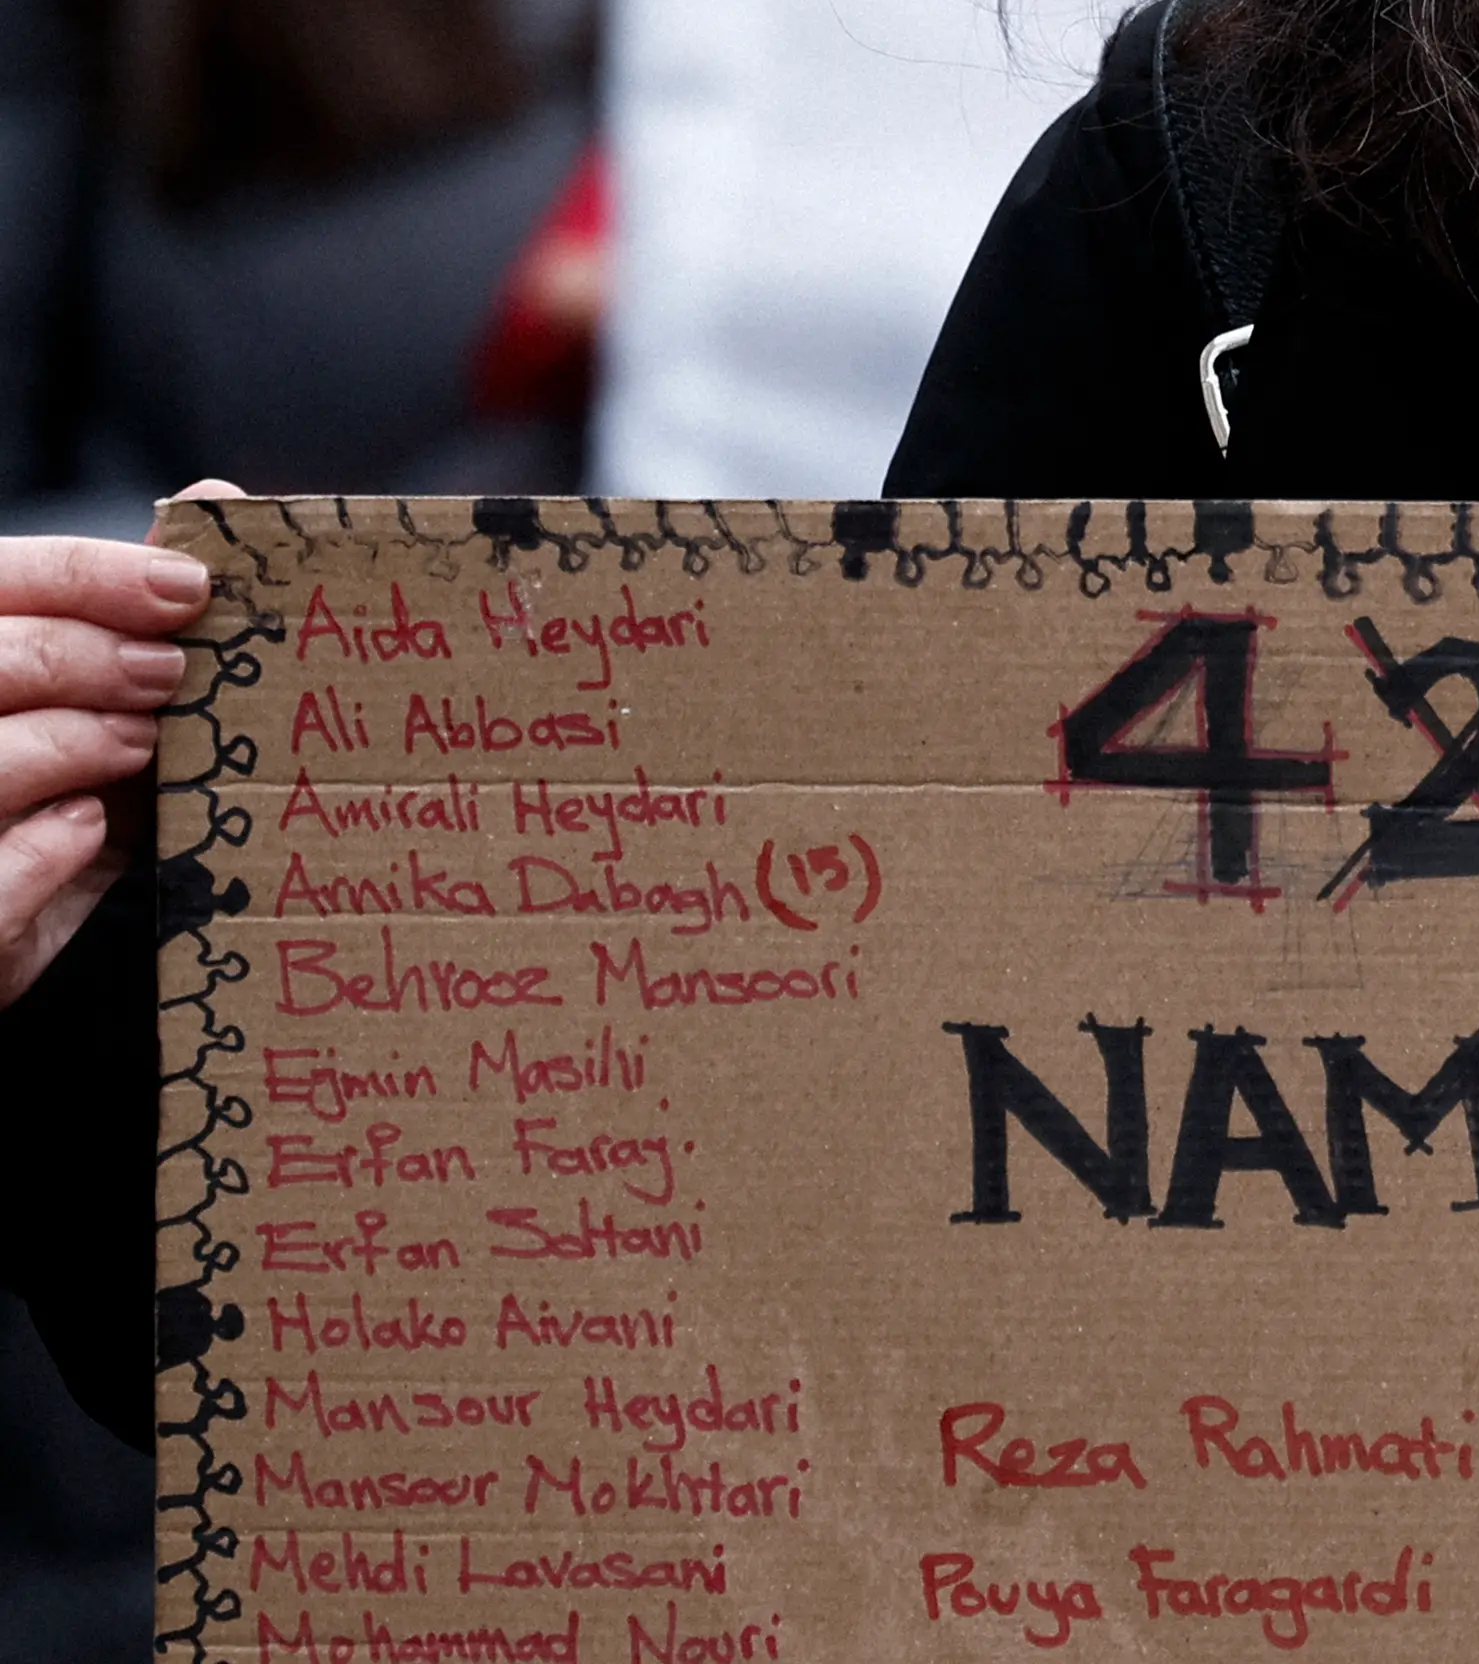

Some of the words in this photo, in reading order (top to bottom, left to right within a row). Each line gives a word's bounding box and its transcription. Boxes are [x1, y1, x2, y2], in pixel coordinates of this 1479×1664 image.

[298, 583, 452, 662] Aida
[480, 581, 709, 690] Heydari
[292, 687, 368, 752] Ali
[406, 694, 619, 753] Abbasi
[281, 769, 478, 836] Amirali
[509, 766, 727, 862] Heydari
[278, 928, 564, 1016] Behrooz
[592, 941, 857, 1007] Mansoori
[266, 1122, 476, 1188] Erfan
[256, 1211, 458, 1274] Erfan
[267, 1371, 538, 1436] Mansour
[584, 1364, 802, 1451] Heydari
[256, 1452, 498, 1510] Mansour
[940, 1403, 1146, 1488] Reza
[251, 1530, 429, 1593] Mehdi
[457, 1537, 727, 1594] Lavasani
[259, 1611, 580, 1664] Mohammad
[920, 1553, 1103, 1647] Pouya
